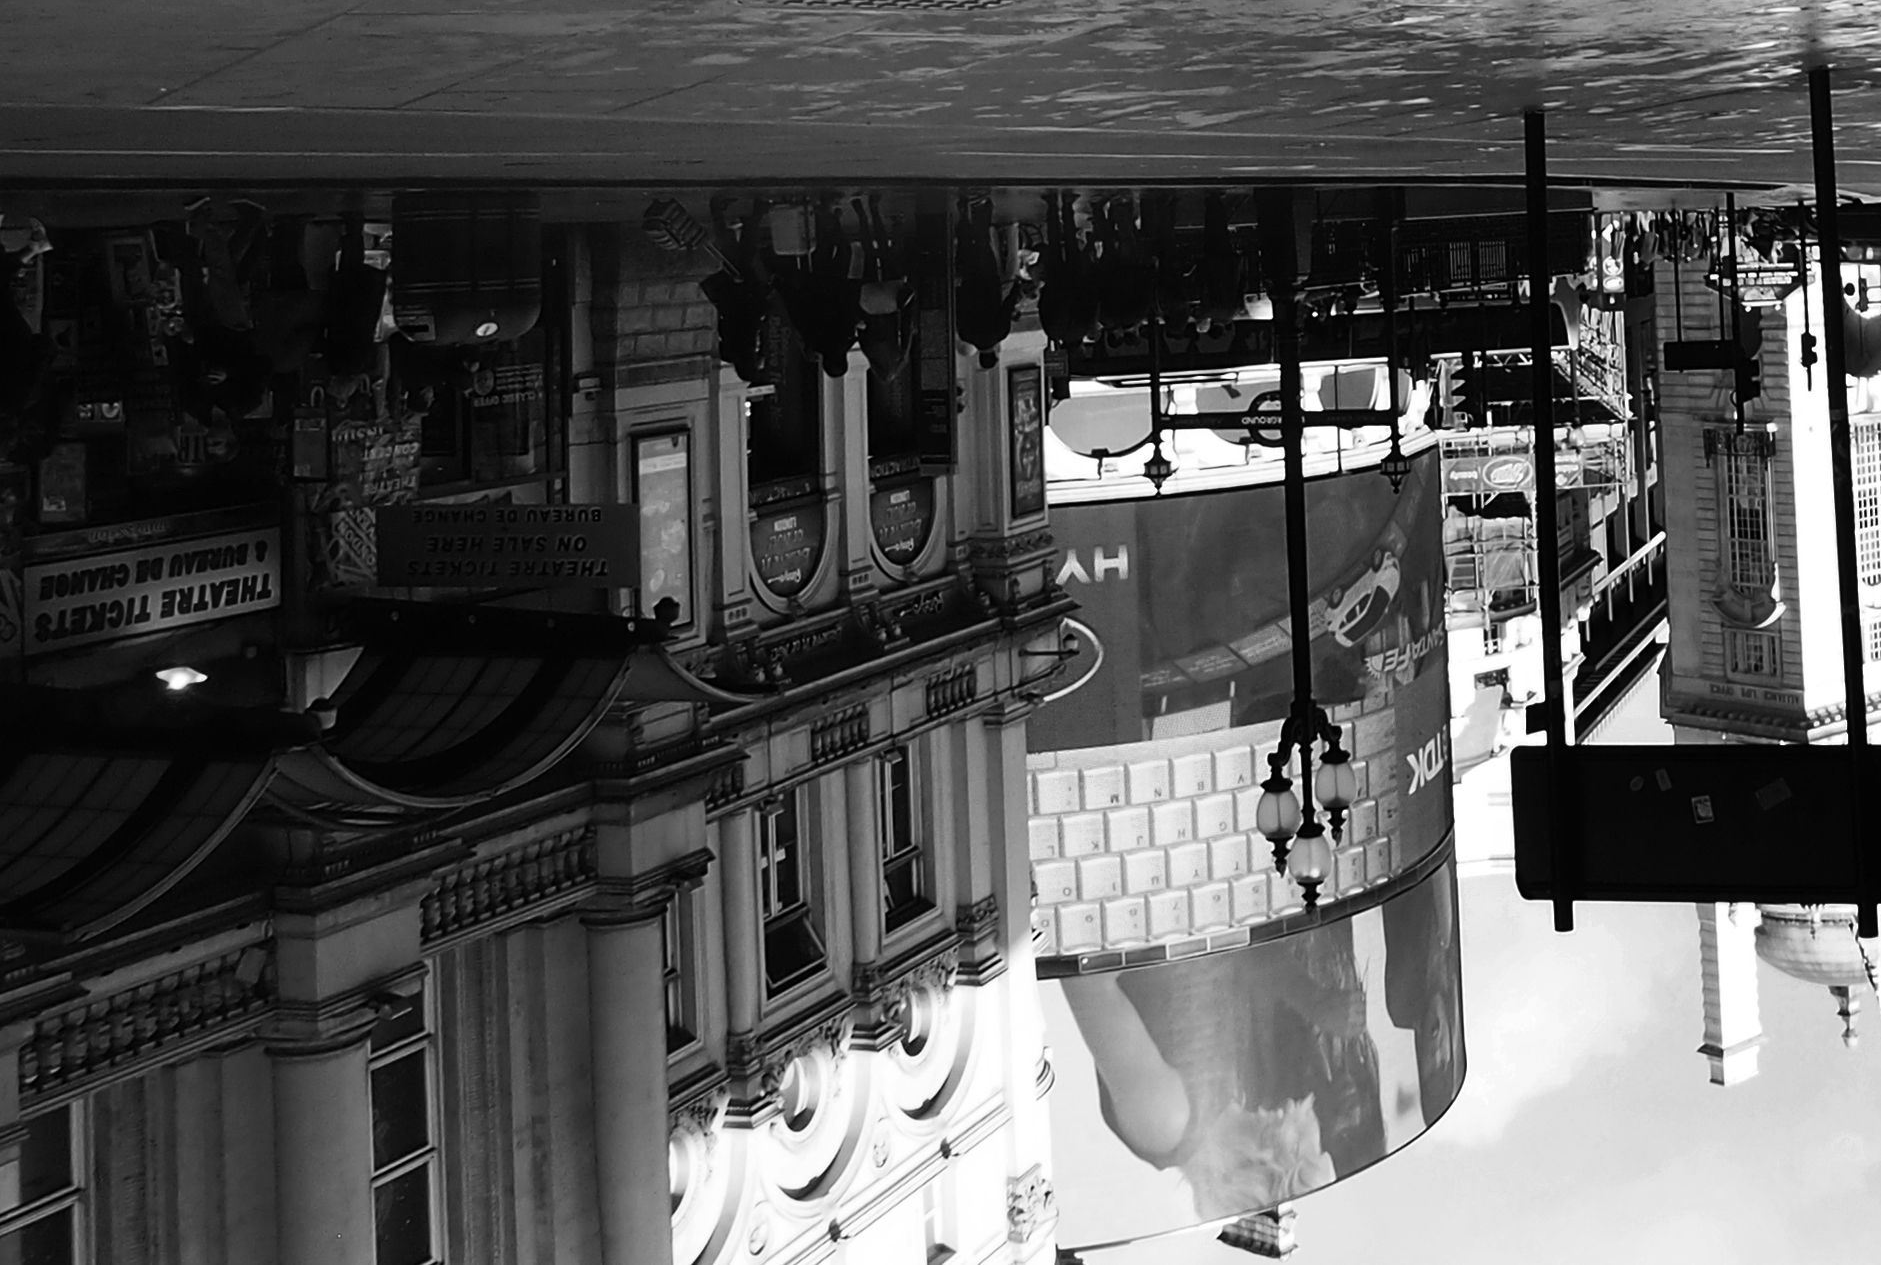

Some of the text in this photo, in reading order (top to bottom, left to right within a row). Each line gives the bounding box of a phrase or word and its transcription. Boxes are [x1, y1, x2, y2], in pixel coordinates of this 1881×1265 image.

[412, 509, 601, 524] BUREAU DE CHANGE
[426, 536, 587, 553] ON SALE HERE
[39, 541, 268, 601] & BUREAU DE CHANGE
[407, 560, 608, 577] THEATRE TICKETS
[35, 573, 272, 643] THEATRE TICKETS
[1406, 732, 1443, 795] TDK
